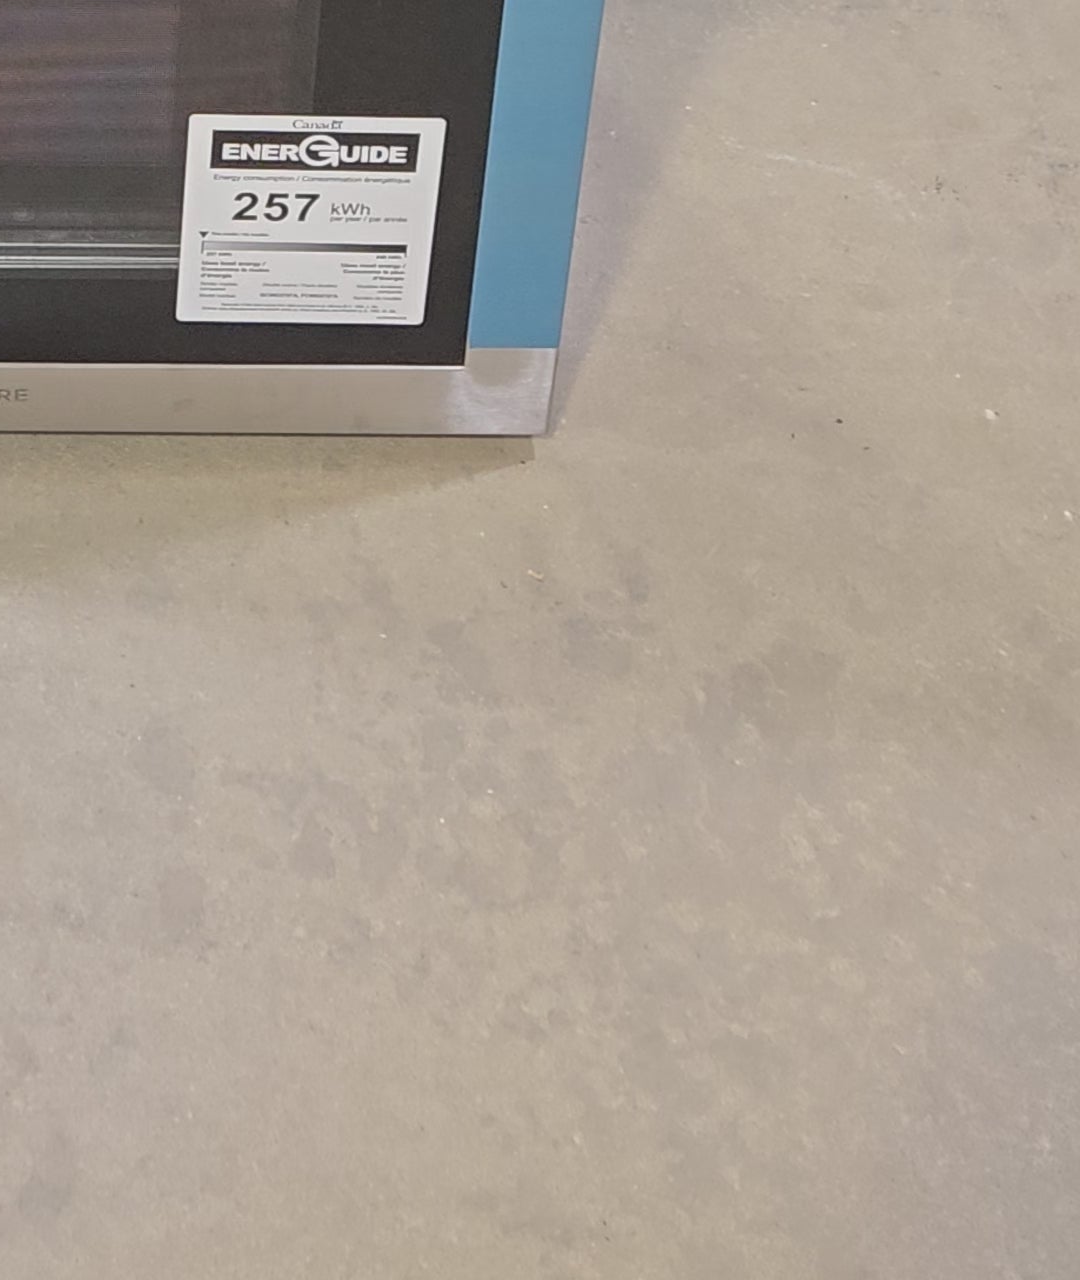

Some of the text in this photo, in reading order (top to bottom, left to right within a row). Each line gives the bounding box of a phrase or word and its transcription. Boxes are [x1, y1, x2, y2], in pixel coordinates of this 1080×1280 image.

[222, 134, 408, 168] ENERGUIDE
[232, 192, 371, 222] 257 kWh
